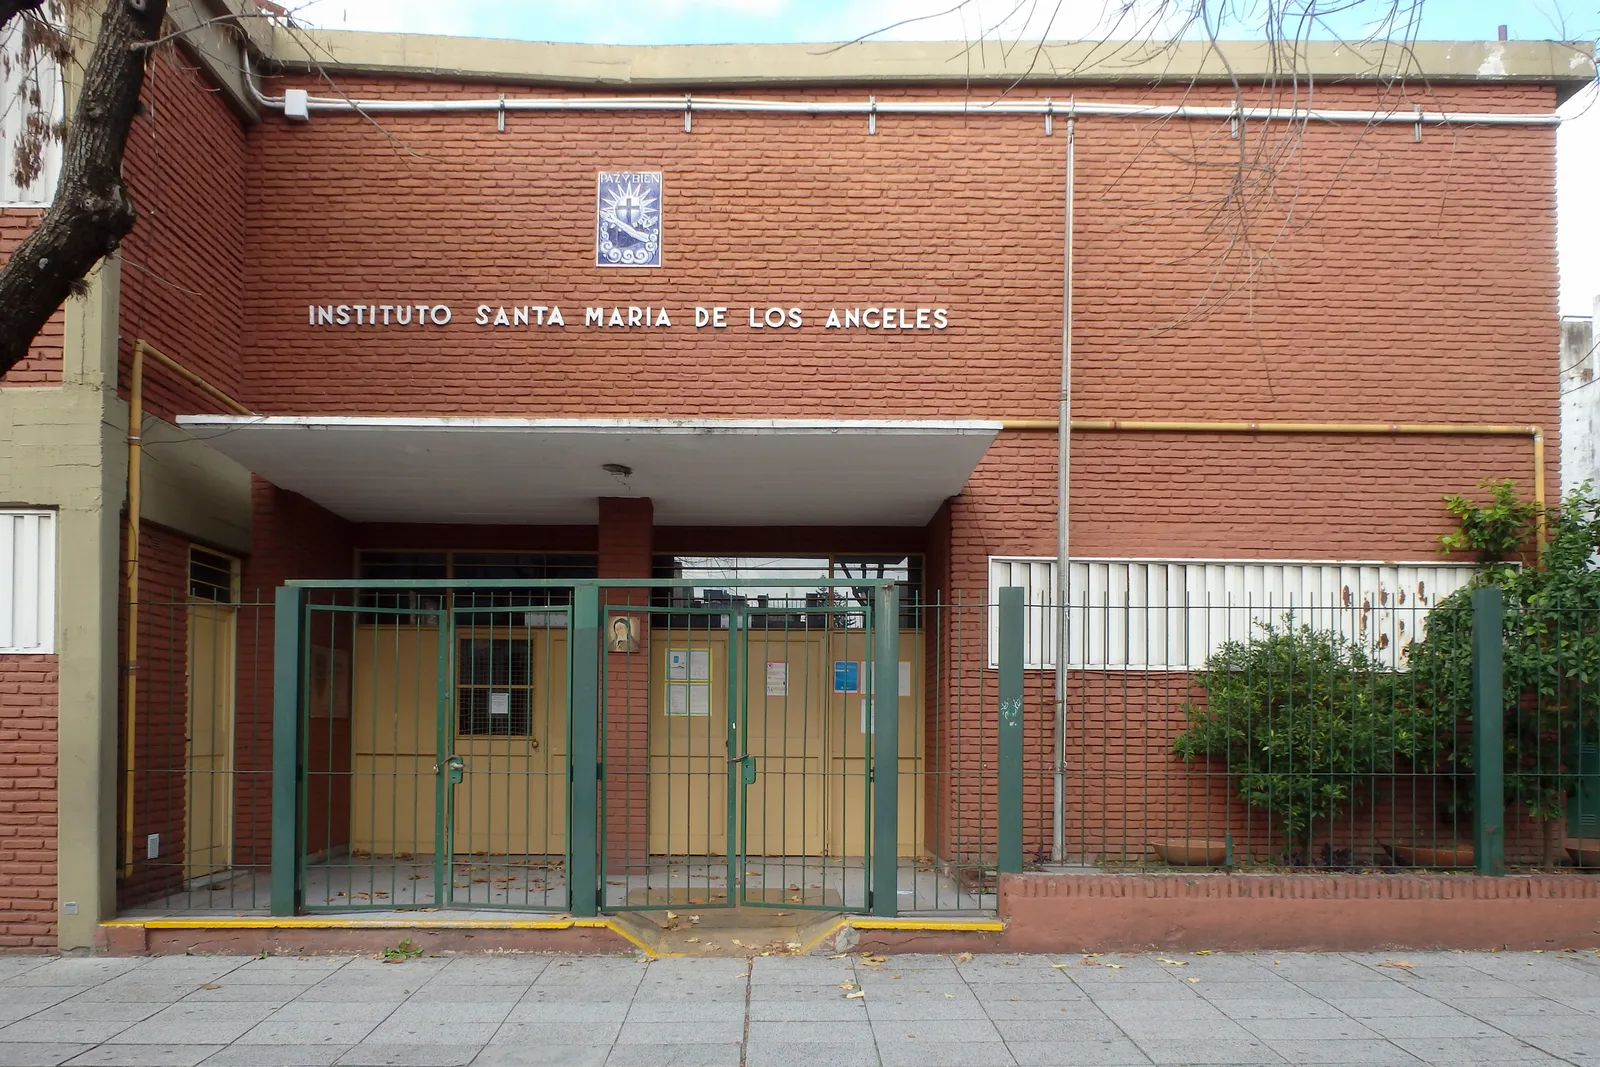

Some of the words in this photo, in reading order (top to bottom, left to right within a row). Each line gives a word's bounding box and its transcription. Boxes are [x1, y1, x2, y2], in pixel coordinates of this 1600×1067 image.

[600, 173, 620, 184] PAZ
[621, 173, 630, 184] Y
[632, 173, 660, 184] BIEN
[309, 304, 452, 326] INSTITUTO
[475, 304, 565, 326] SANTA
[585, 305, 672, 328] MARIA
[695, 306, 728, 328] DE
[749, 306, 803, 329] LOS
